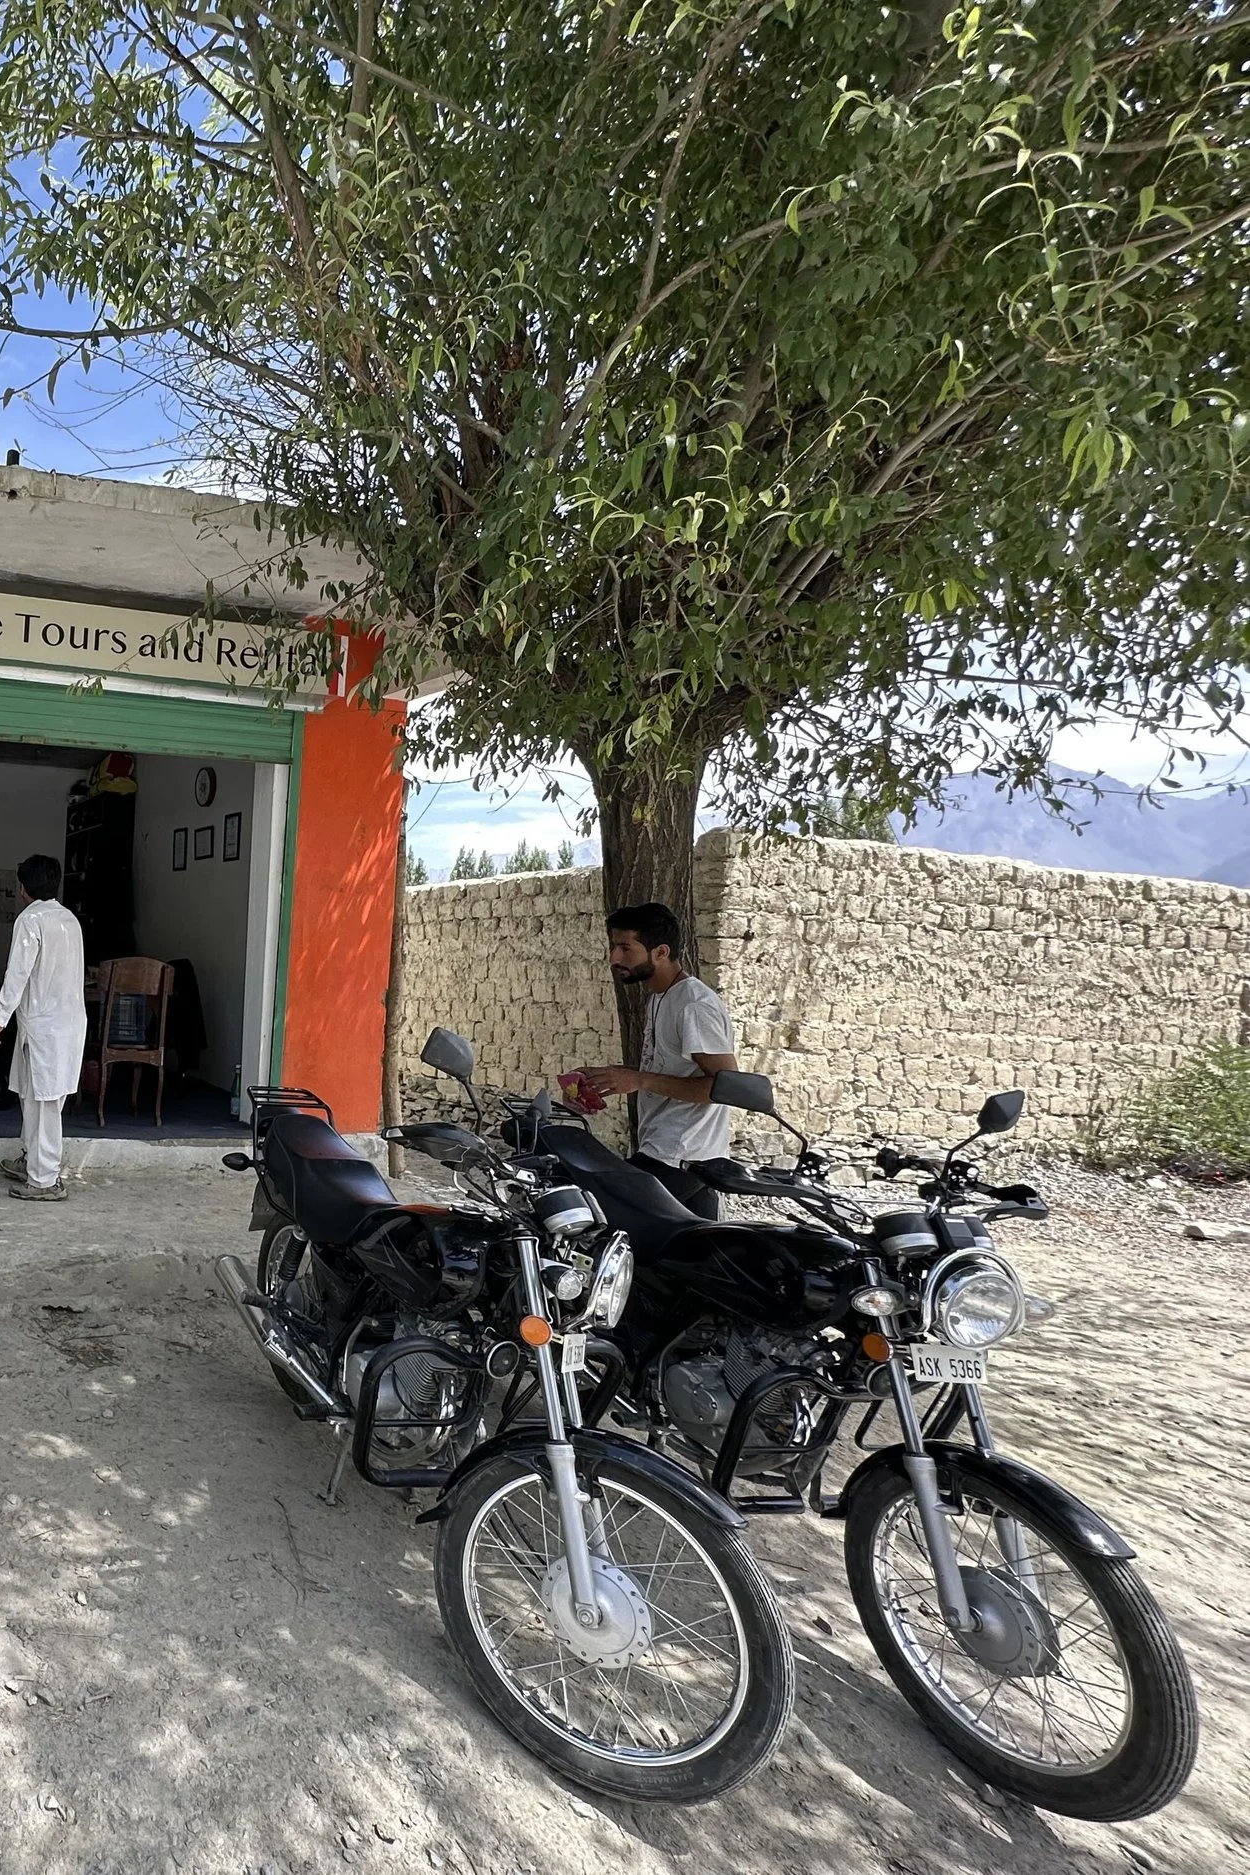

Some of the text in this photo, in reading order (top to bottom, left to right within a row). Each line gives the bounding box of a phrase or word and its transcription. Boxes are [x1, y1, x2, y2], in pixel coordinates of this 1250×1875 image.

[14, 612, 128, 654] Tours
[919, 1357, 982, 1379] ASK 5366
